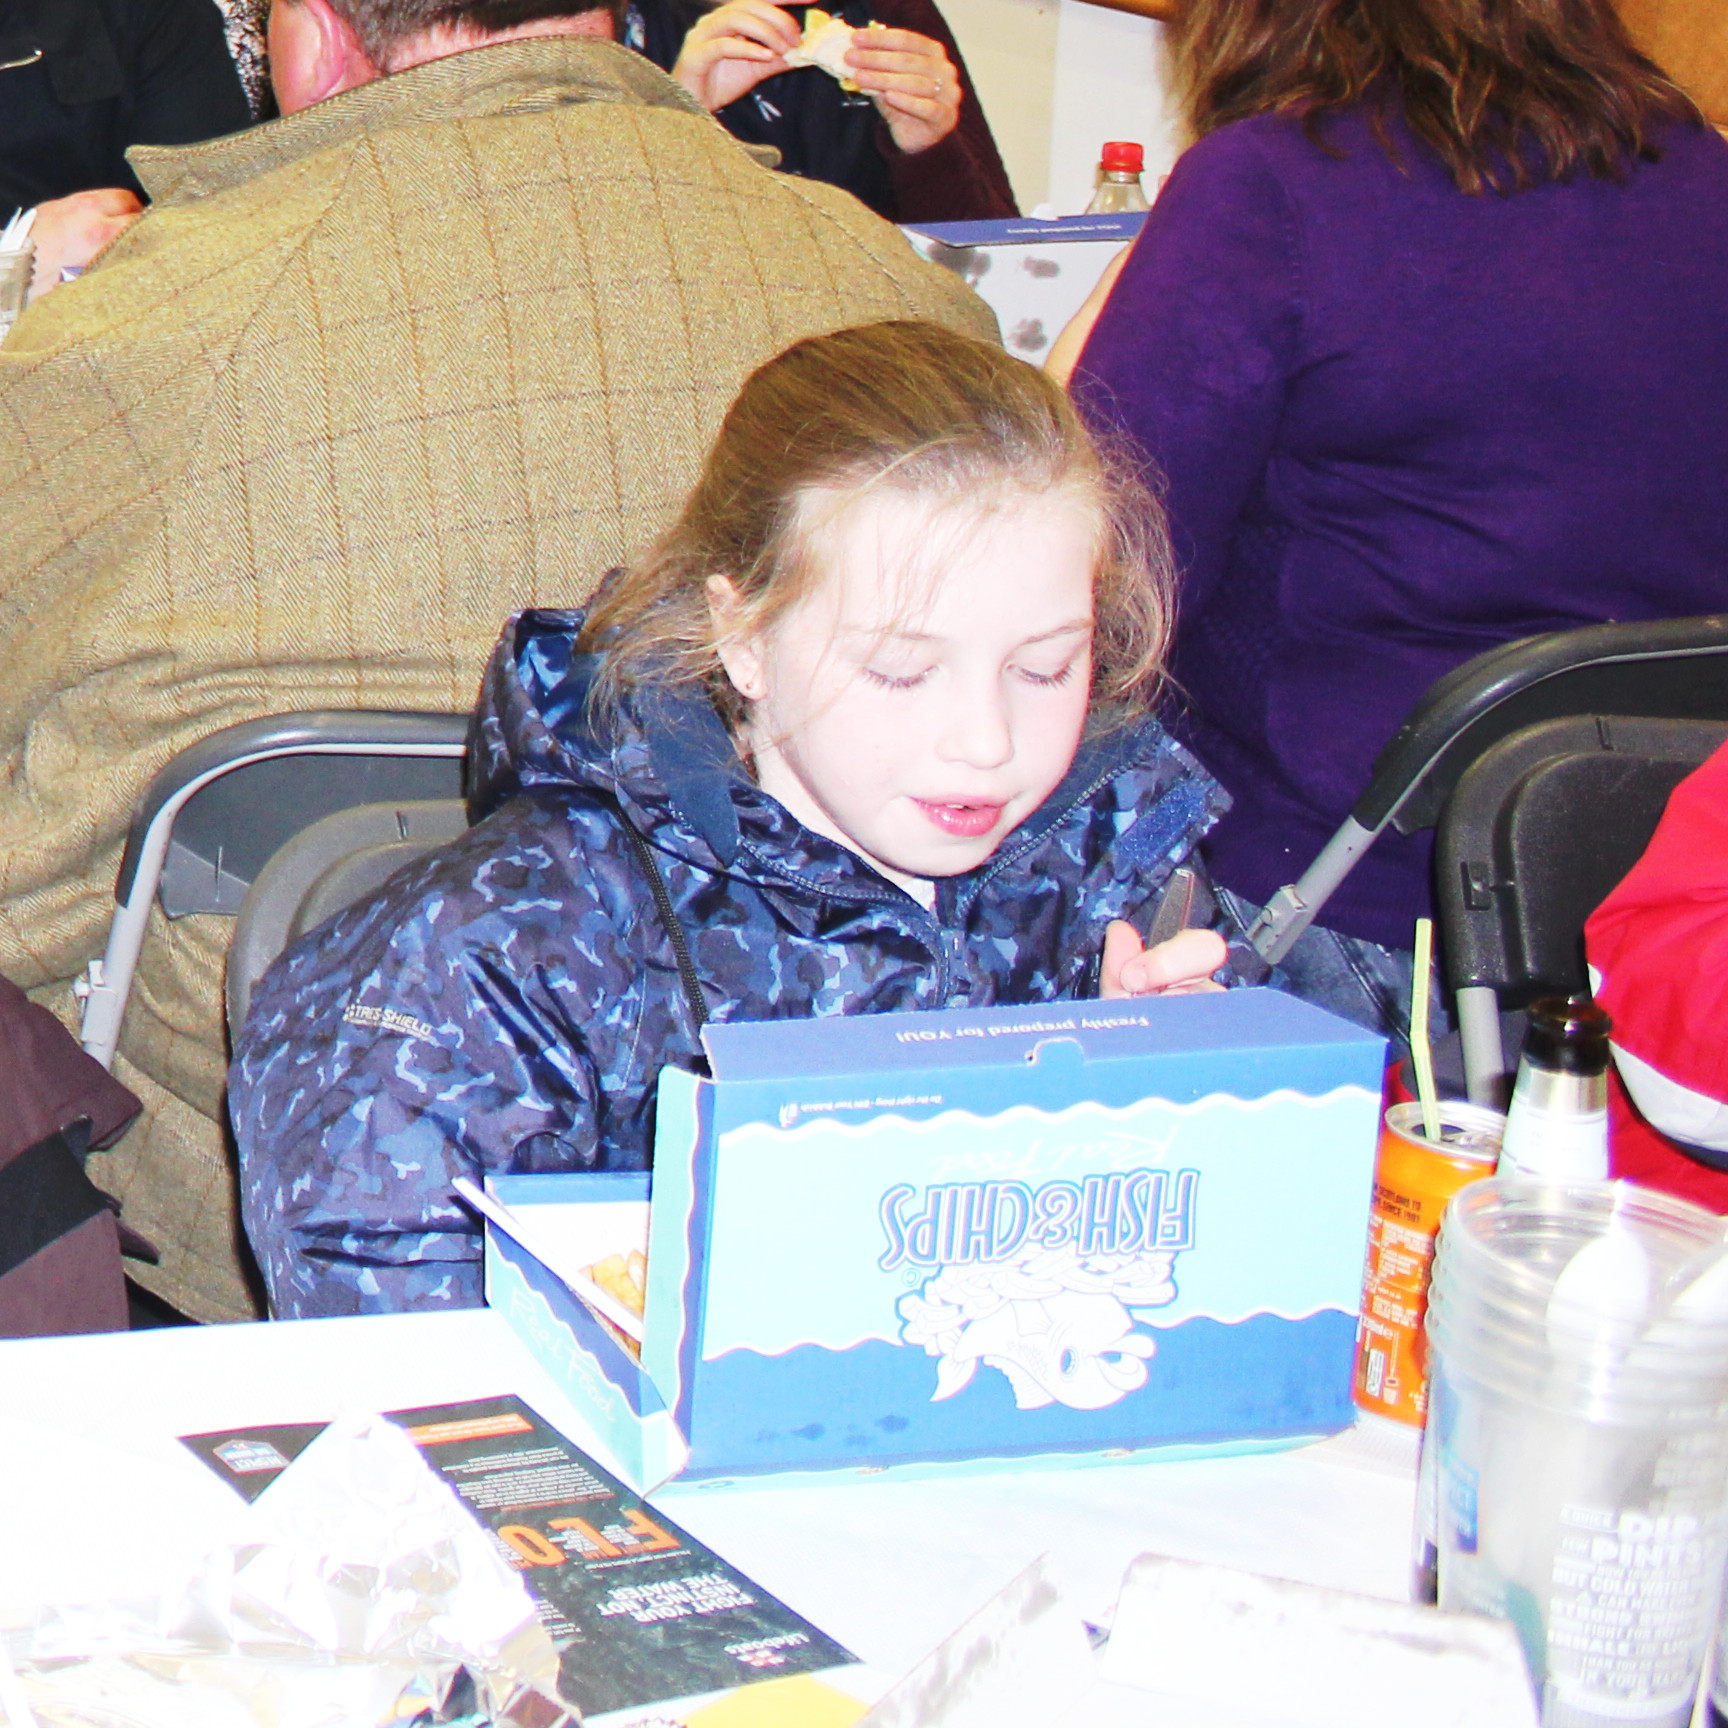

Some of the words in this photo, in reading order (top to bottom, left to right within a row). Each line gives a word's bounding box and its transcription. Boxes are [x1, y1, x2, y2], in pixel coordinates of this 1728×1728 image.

[955, 1026, 984, 1038] for
[988, 1020, 1077, 1037] prepared
[1082, 1016, 1149, 1031] Freshly
[895, 1029, 951, 1043] YOU!
[1383, 1202, 1403, 1219] SINCE
[1411, 1201, 1422, 1212] TO
[1617, 1508, 1697, 1541] DIP
[1591, 1536, 1703, 1570] PINTS
[681, 1573, 729, 1590] THE
[1553, 1565, 1590, 1589] BUT
[1591, 1576, 1635, 1595] COLD
[1640, 1579, 1688, 1596] WATER
[607, 1581, 684, 1601] WATER
[596, 1601, 641, 1617] NOT
[694, 1593, 757, 1614] FIGHT
[630, 1605, 693, 1622] YOUR
[724, 1632, 810, 1655] Lifeboats
